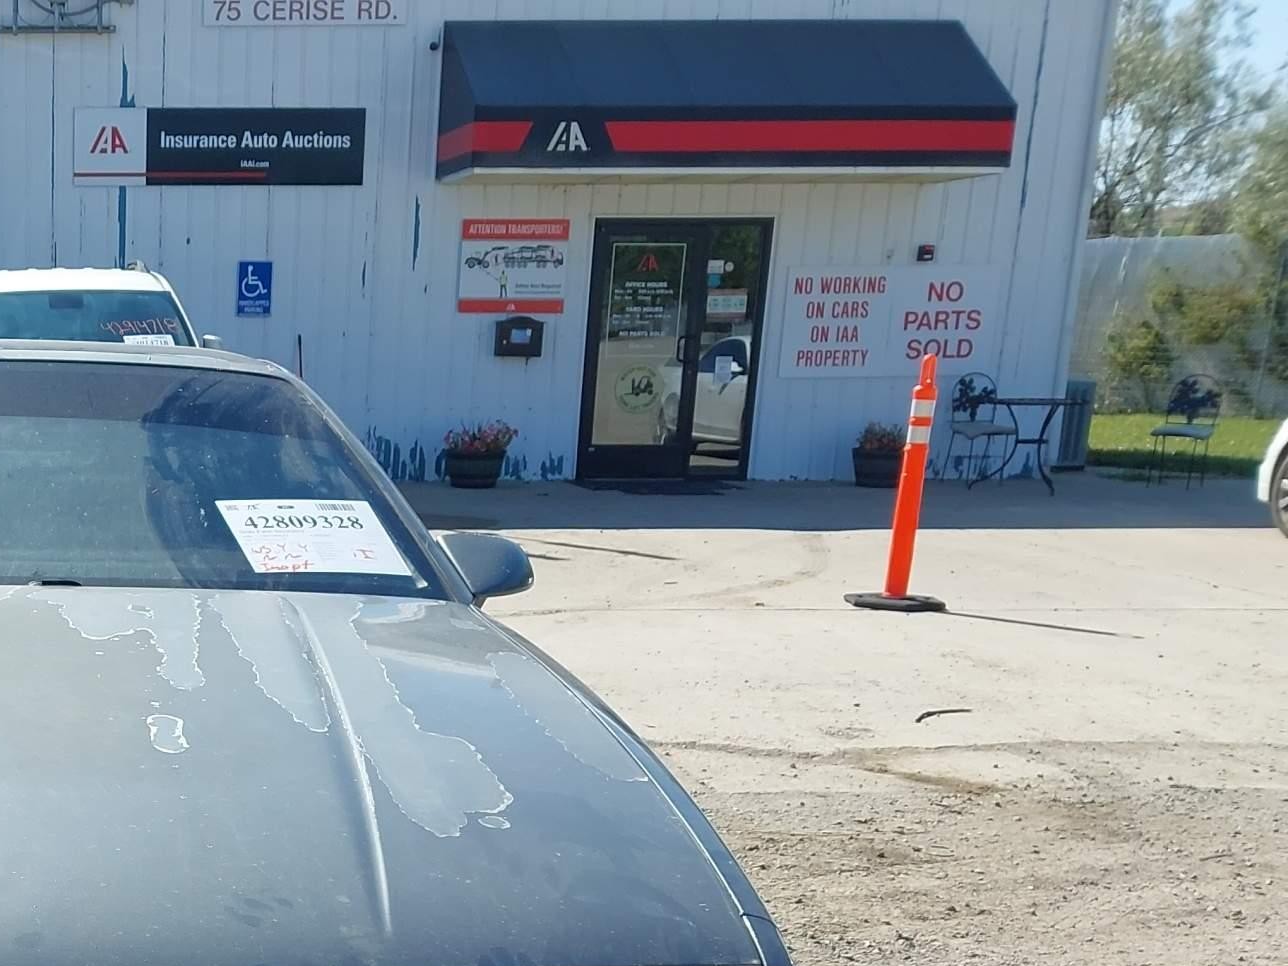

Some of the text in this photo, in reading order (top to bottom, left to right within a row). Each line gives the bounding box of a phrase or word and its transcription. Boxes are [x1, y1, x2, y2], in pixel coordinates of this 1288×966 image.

[213, 0, 397, 21] 75 CERISE RD.
[160, 130, 351, 148] Insurance Auto Auctions
[469, 223, 506, 234] ATTENTION
[794, 276, 887, 295] NO WORKING
[927, 281, 964, 302] NO
[806, 301, 869, 319] ON CARS
[903, 310, 982, 331] PARTS
[810, 326, 859, 343] ON IAA
[905, 338, 973, 360] SOLD
[796, 350, 869, 367] PROPERTY
[244, 515, 364, 530] 42809328
